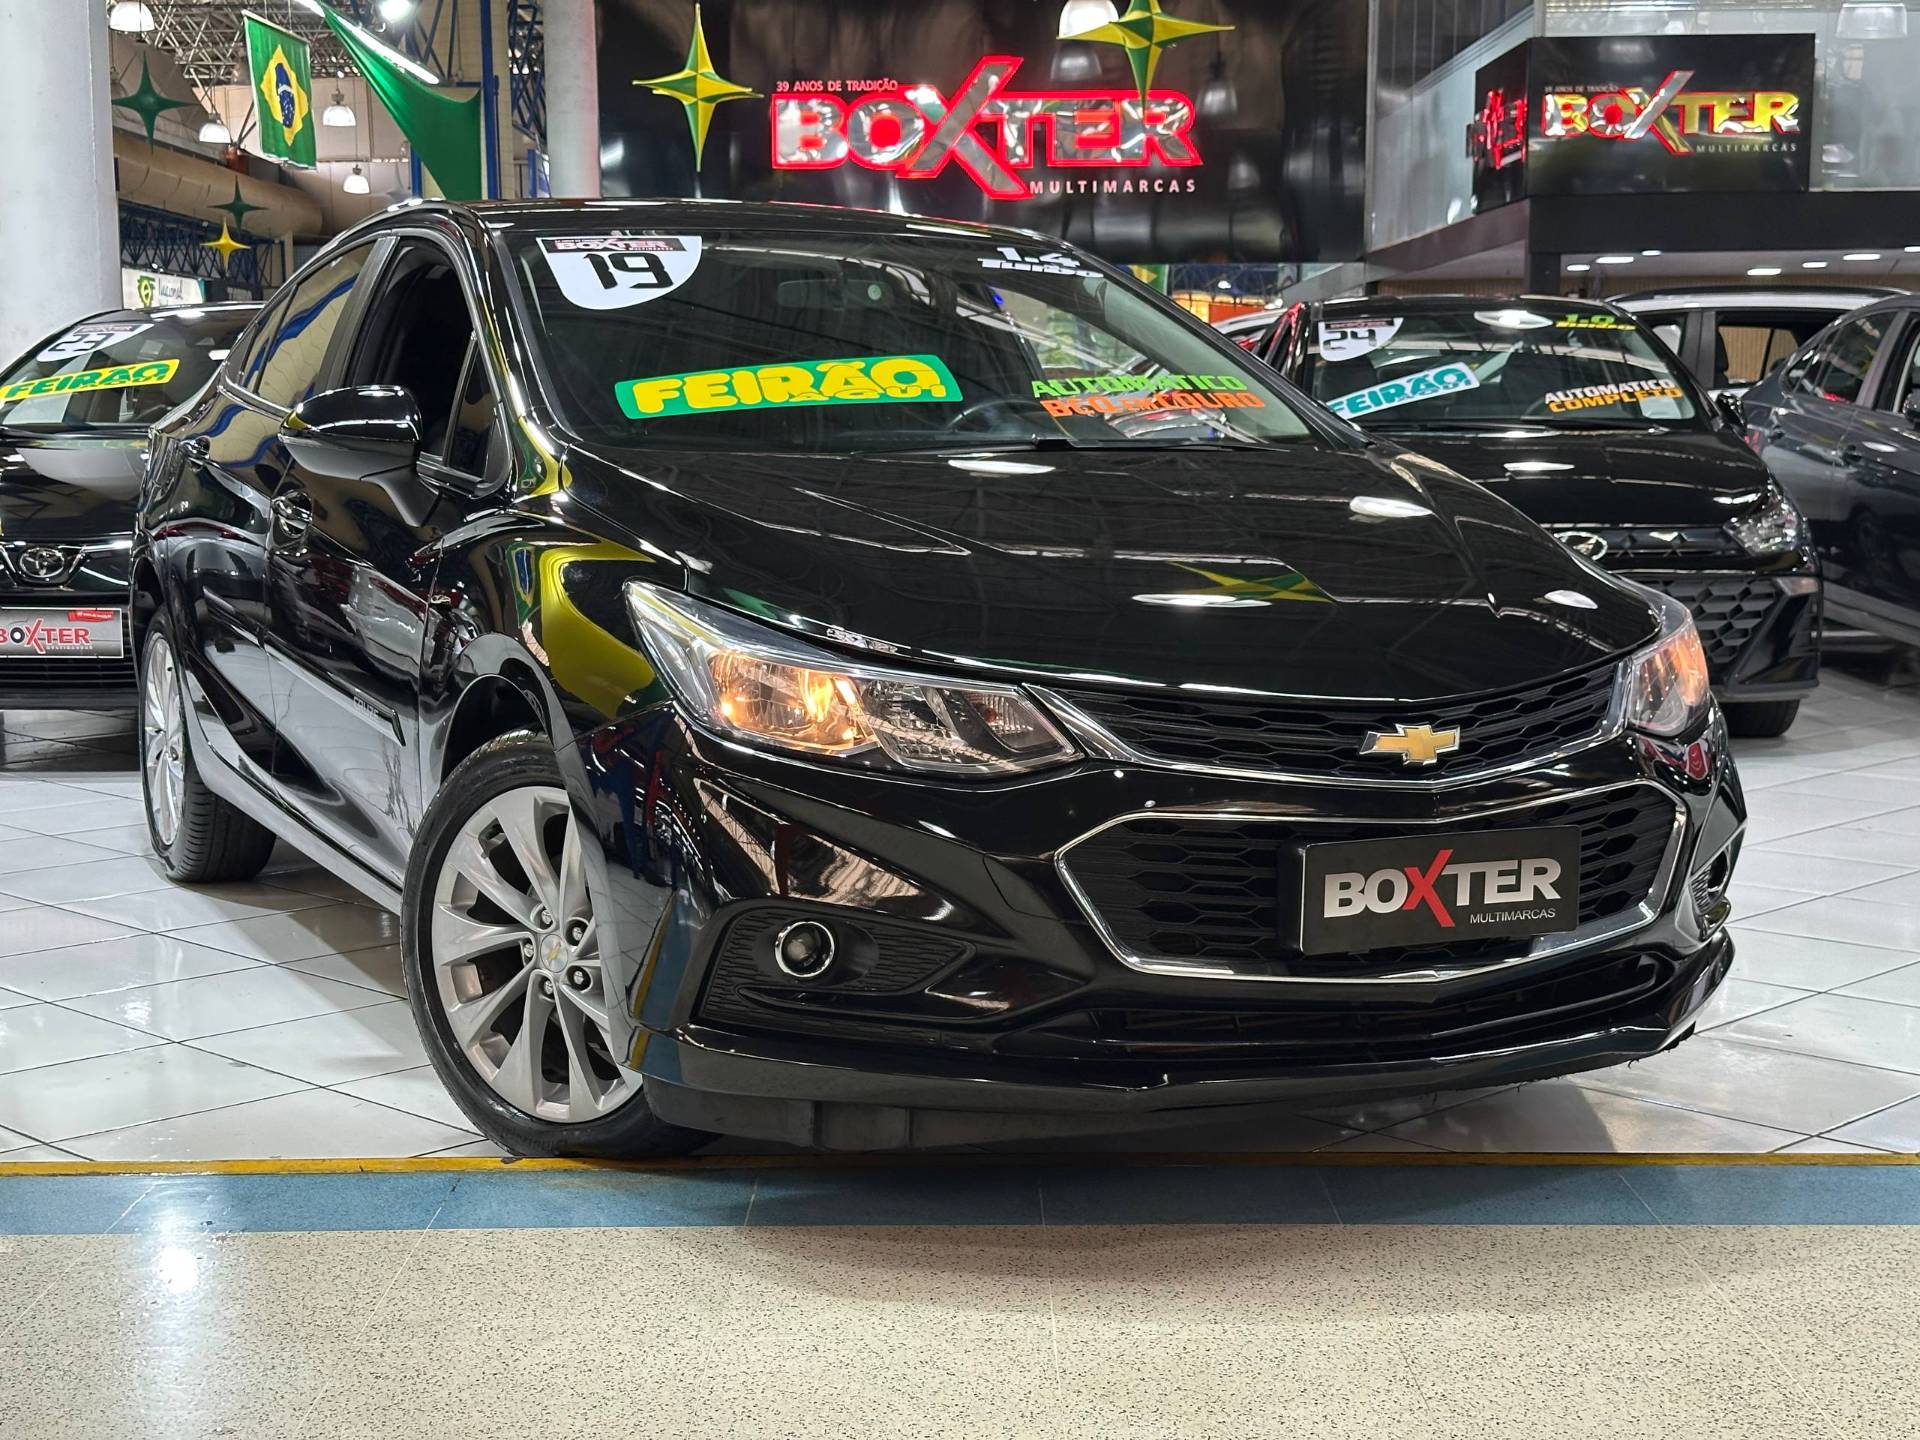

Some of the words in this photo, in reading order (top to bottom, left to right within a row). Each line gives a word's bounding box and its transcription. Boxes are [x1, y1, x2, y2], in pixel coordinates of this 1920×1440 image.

[776, 81, 789, 92] 39
[793, 81, 823, 92] ANOS
[828, 81, 842, 92] DE
[846, 78, 898, 92] TRADIÇÃO
[1542, 70, 1801, 156] BOXTER
[771, 55, 1203, 200] BOXTER
[1696, 143, 1797, 153] MULTIMARCAS
[1029, 179, 1196, 194] MULTIMARCAS
[554, 238, 668, 251] BOXTER
[583, 253, 674, 289] 19
[1323, 328, 1377, 350] 24
[5, 363, 170, 398] FEIRÃO
[632, 358, 941, 414] FEIRÃO
[1330, 367, 1467, 414] FEIRÃO
[1545, 378, 1677, 405] AUTOMATICO
[1153, 391, 1264, 411] COURO
[1549, 387, 1684, 413] COMPLETO
[1323, 849, 1562, 928] BOXTER
[1469, 907, 1556, 924] MULTIMARCAS
